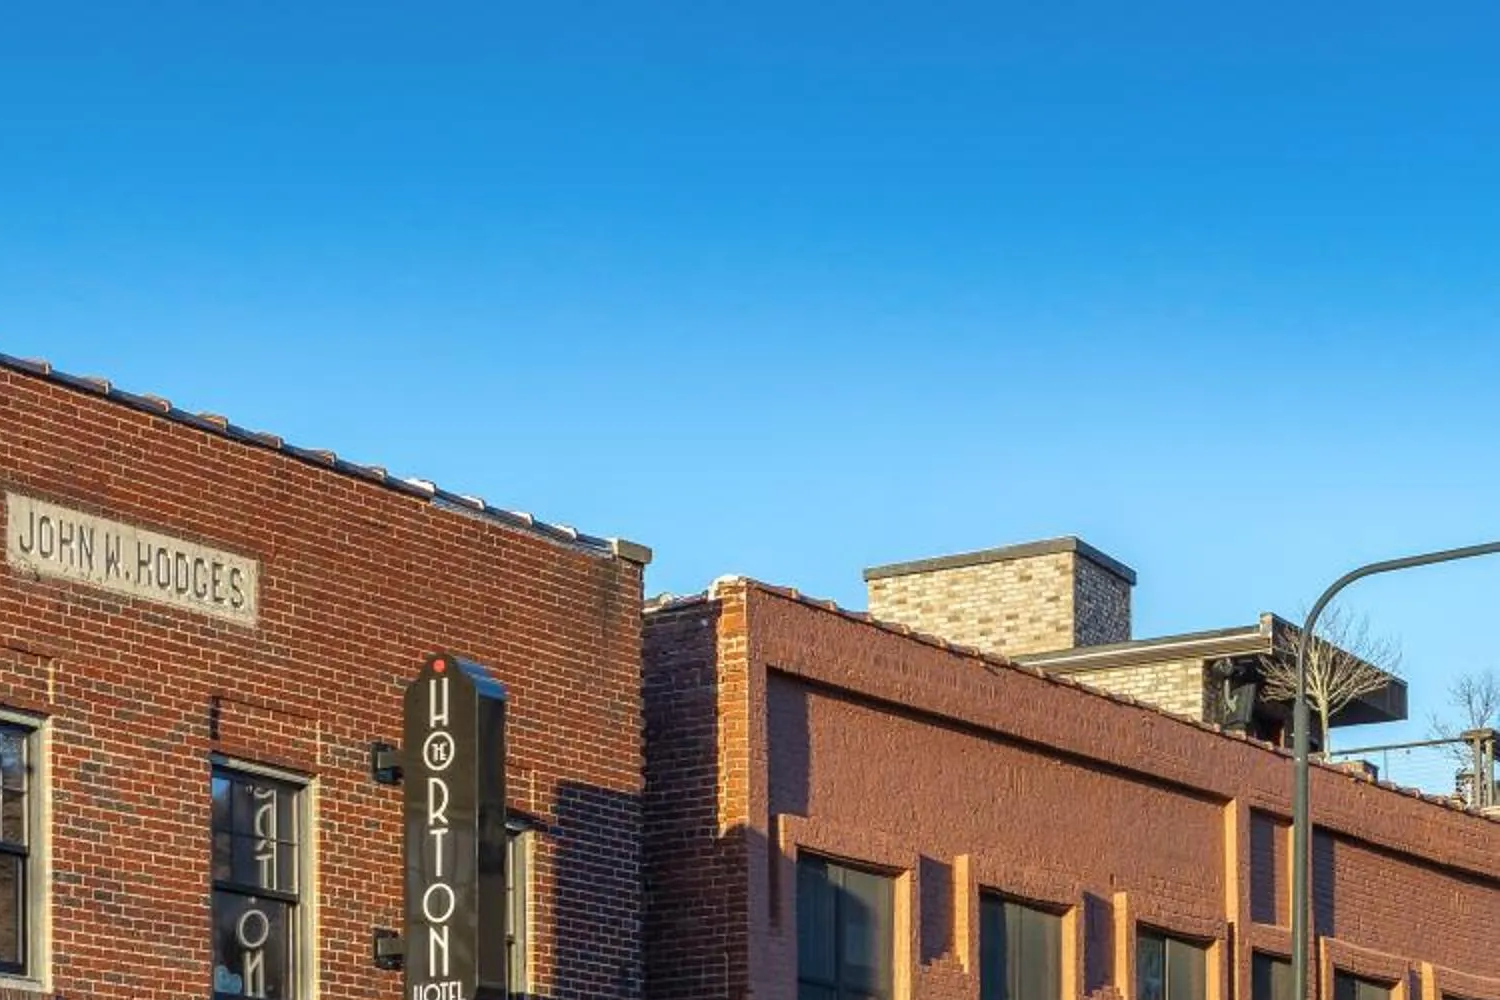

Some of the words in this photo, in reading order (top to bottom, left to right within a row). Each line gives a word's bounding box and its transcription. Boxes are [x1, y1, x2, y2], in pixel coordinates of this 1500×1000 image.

[19, 511, 94, 571] JOHN
[137, 540, 245, 609] HODGES
[423, 677, 455, 977] HORTON
